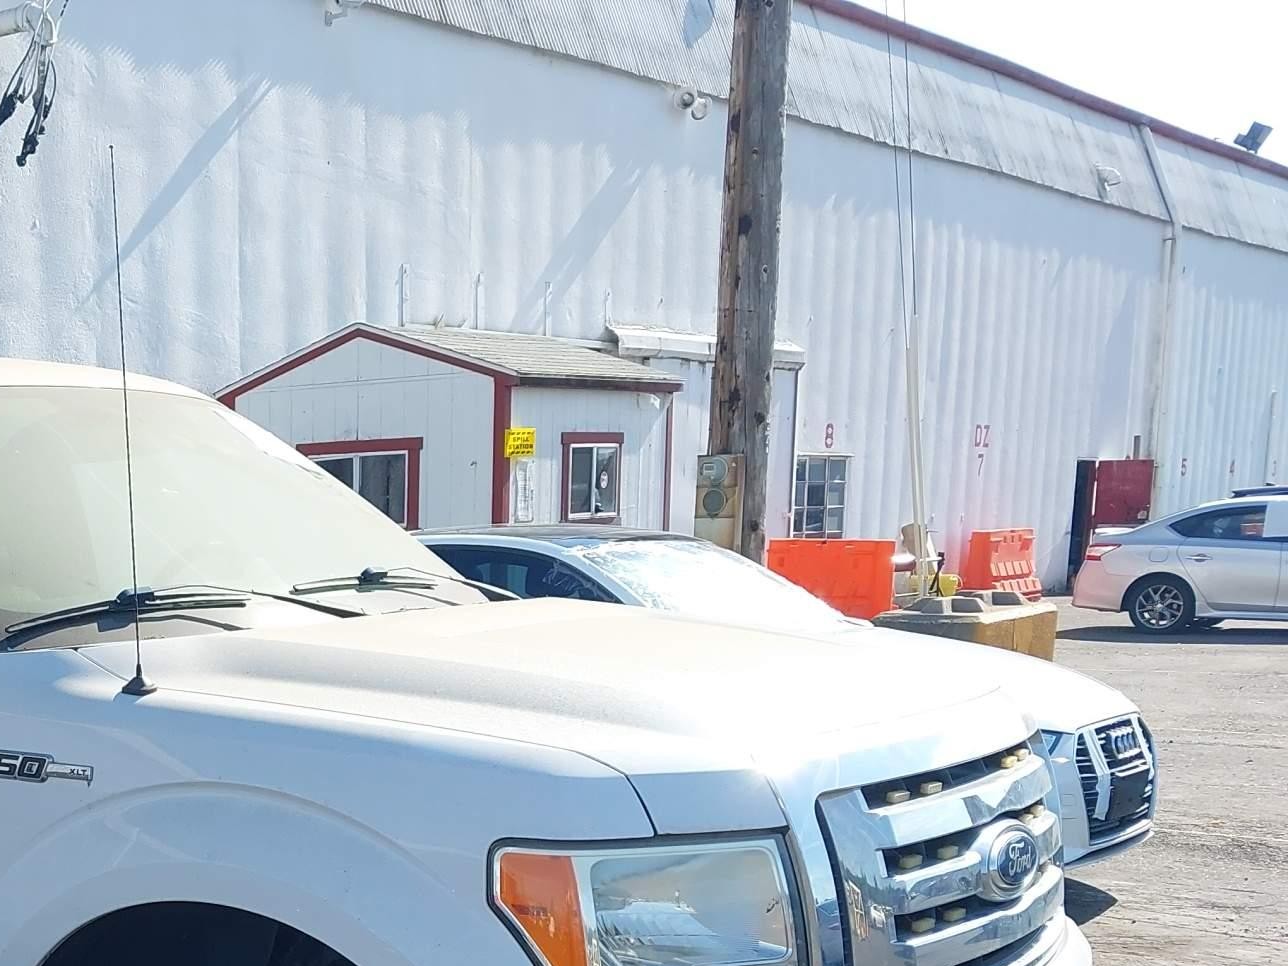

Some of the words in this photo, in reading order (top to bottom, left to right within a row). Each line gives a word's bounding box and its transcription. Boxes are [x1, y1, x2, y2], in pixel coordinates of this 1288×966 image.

[824, 423, 834, 448] 8
[974, 424, 990, 448] DZ
[977, 454, 984, 477] 7
[1180, 458, 1188, 477] 5
[68, 767, 88, 777] XLT
[1008, 841, 1032, 876] Ford
